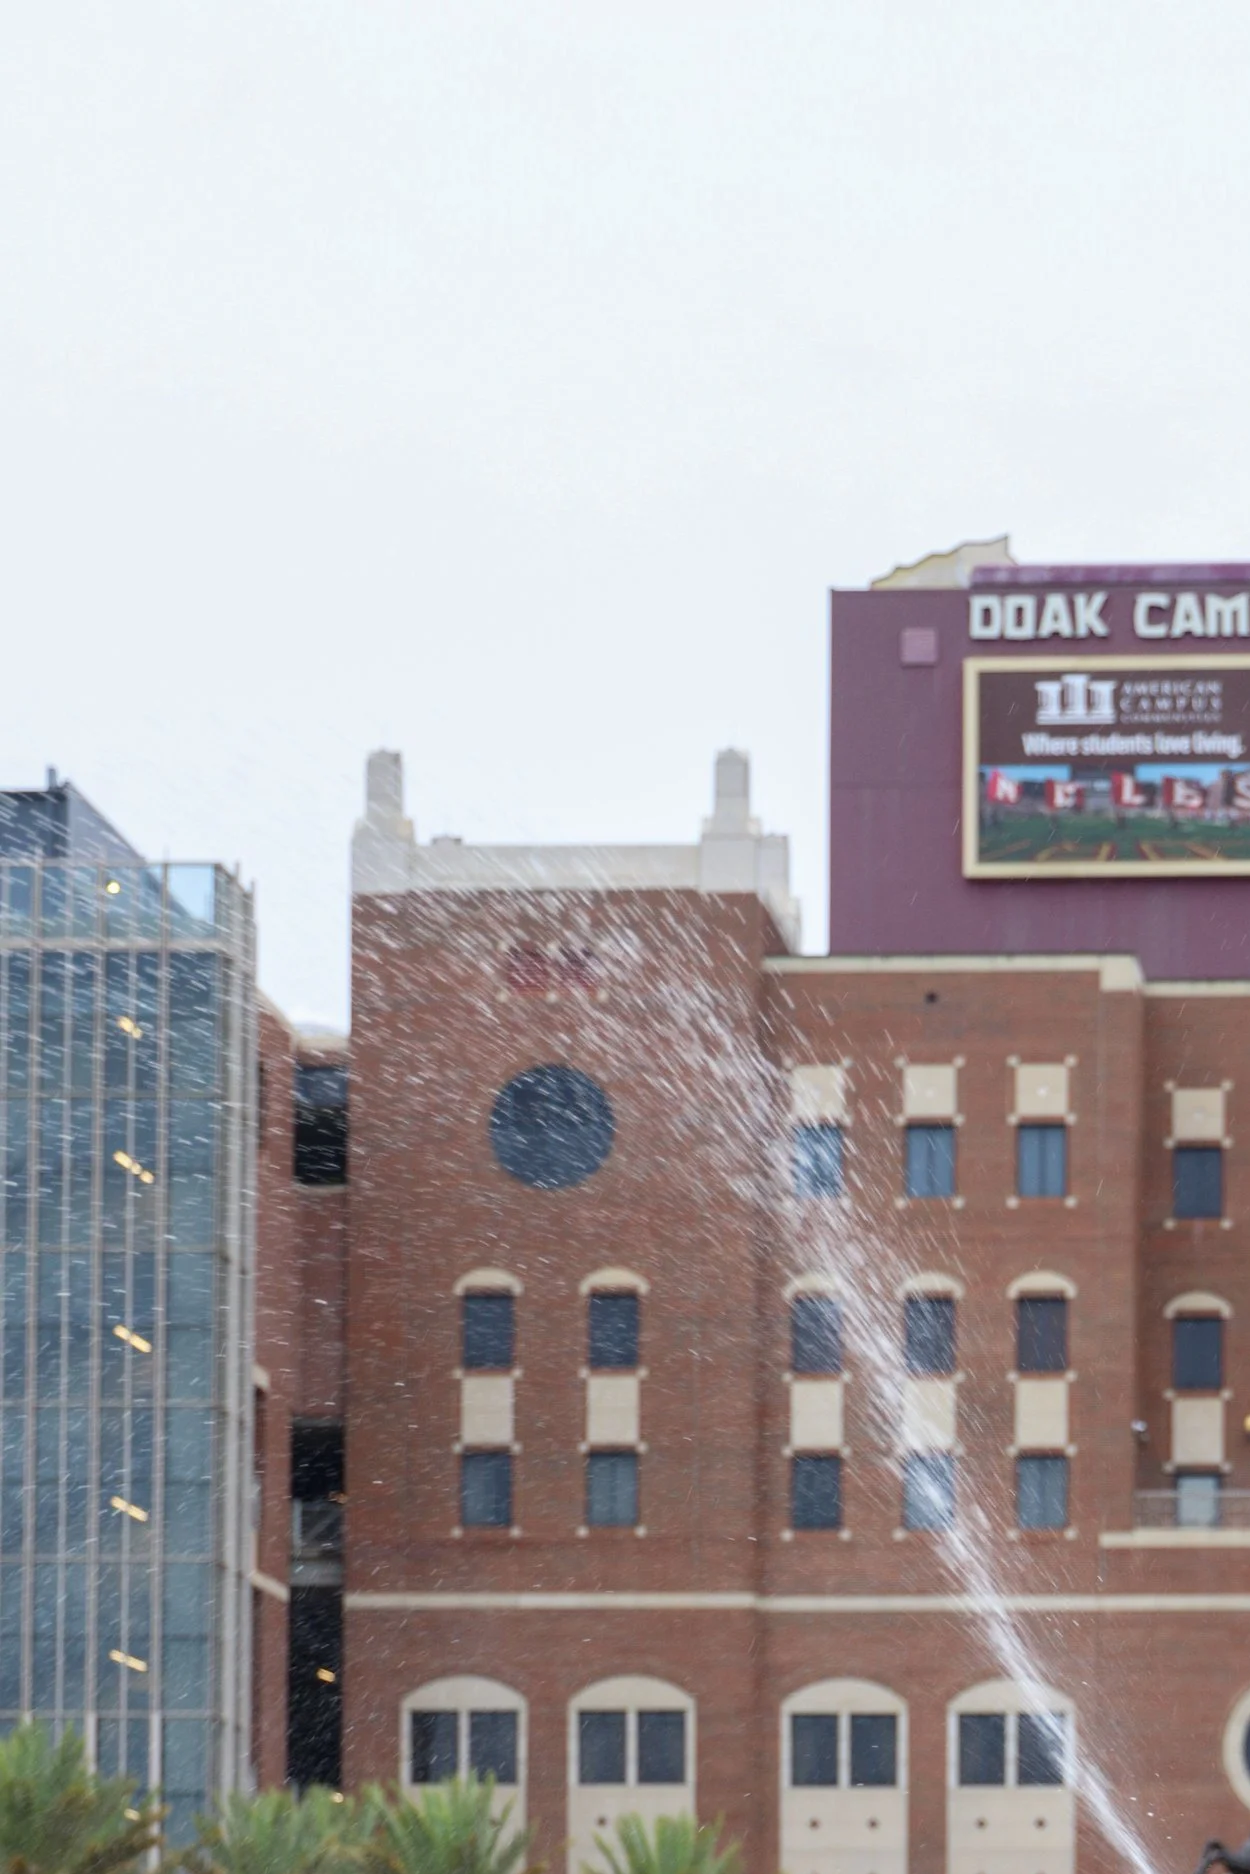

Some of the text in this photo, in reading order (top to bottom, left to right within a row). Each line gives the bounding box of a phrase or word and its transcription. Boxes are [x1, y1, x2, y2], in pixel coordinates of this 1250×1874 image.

[970, 592, 1109, 640] DOAK
[1021, 733, 1078, 756] Where
[1080, 732, 1153, 755] students
[1154, 732, 1191, 754] love
